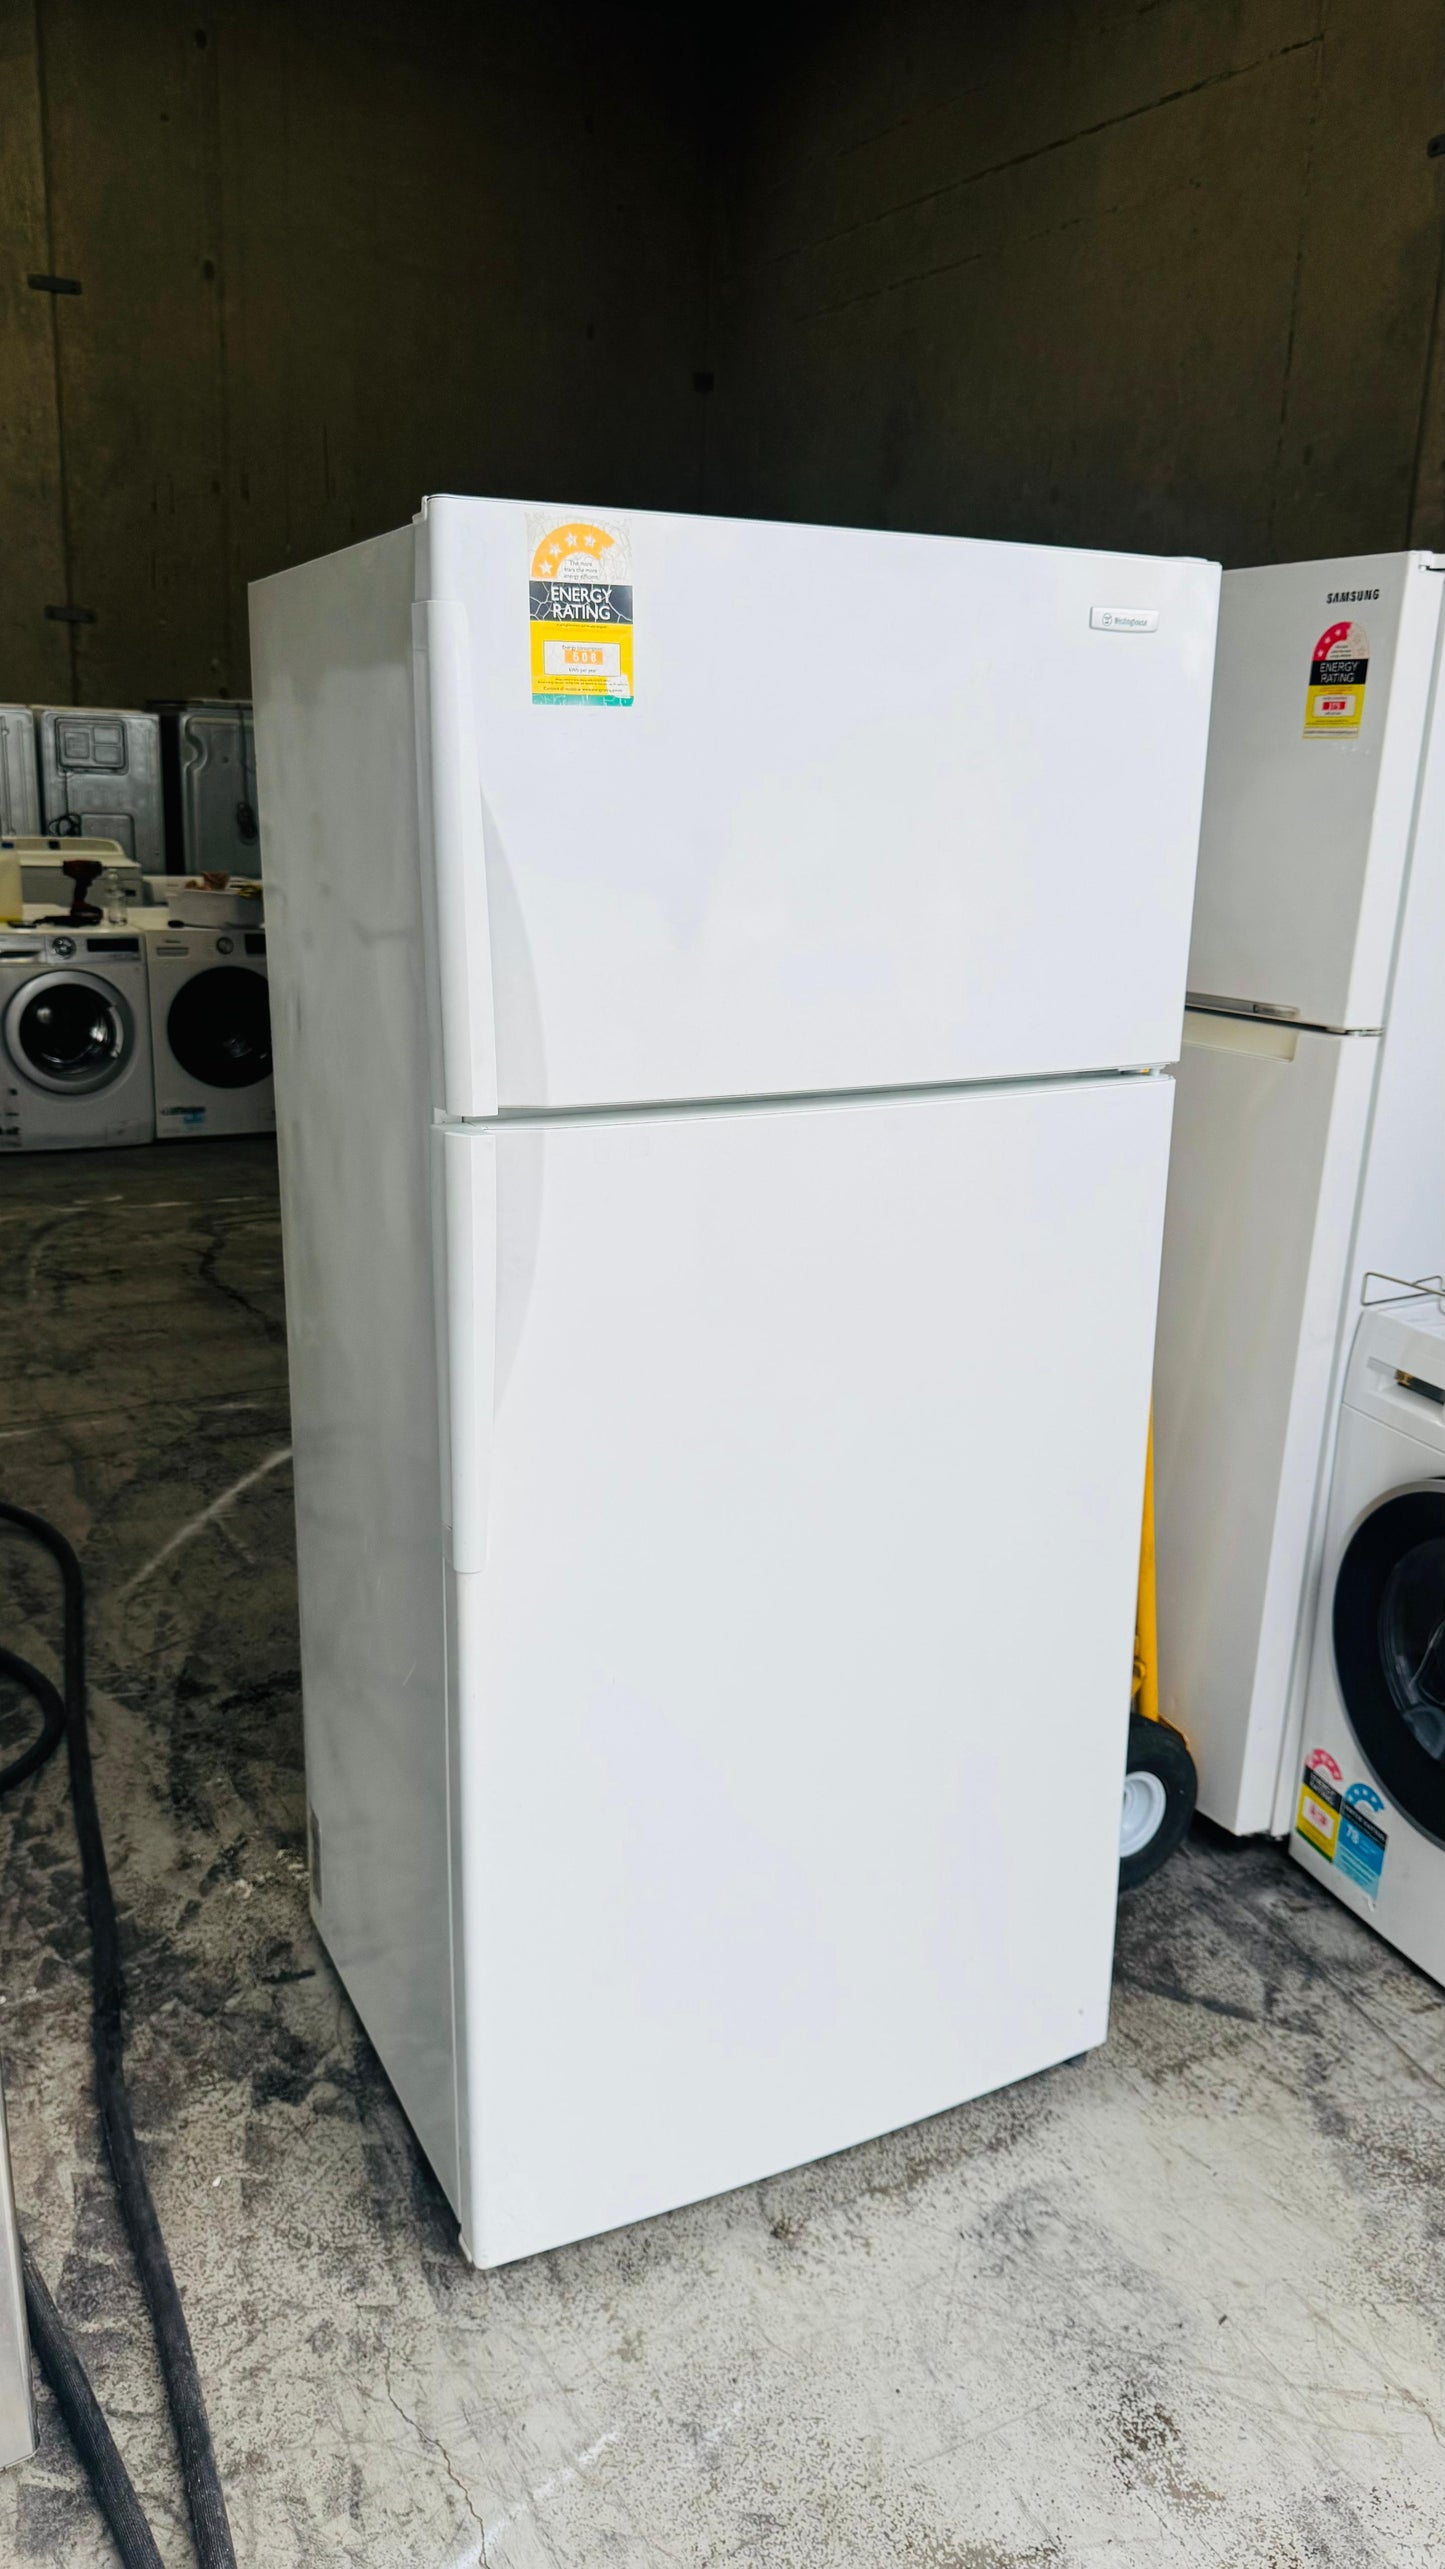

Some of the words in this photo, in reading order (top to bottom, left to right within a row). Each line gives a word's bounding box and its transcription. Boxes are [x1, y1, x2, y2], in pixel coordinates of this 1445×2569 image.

[551, 586, 612, 603] ENERGY
[1326, 589, 1380, 604] SAMSUNG
[553, 603, 610, 620] RATING
[1320, 661, 1359, 673] ENERGY
[1320, 672, 1355, 683] RATING
